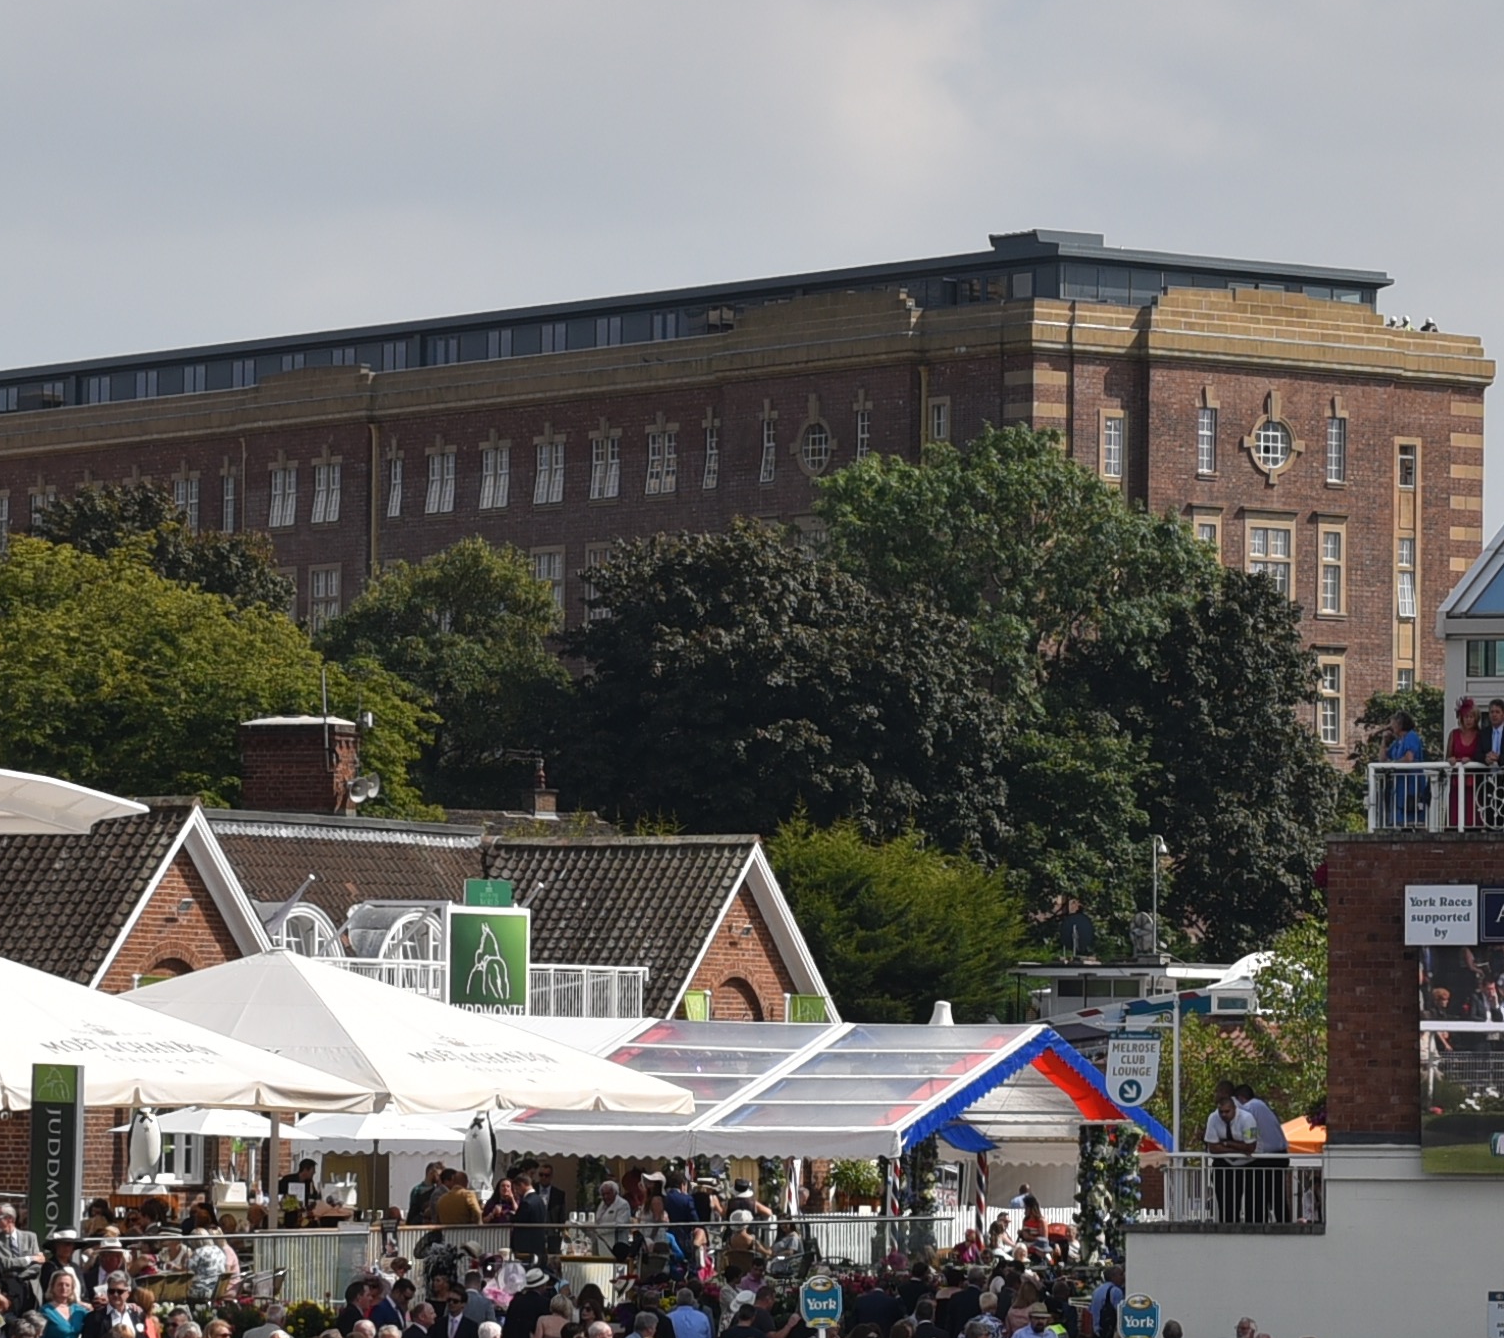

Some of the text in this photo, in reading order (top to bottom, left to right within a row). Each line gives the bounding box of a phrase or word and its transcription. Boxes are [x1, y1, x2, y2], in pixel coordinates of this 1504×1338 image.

[1409, 895, 1473, 908] York Races
[1410, 910, 1472, 925] supported
[1433, 925, 1449, 939] by
[1111, 1042, 1157, 1053] MELROSE
[1120, 1054, 1146, 1065] CLUB
[1112, 1066, 1152, 1077] LOUNGE
[807, 1297, 837, 1311] York
[1123, 1315, 1155, 1328] York
